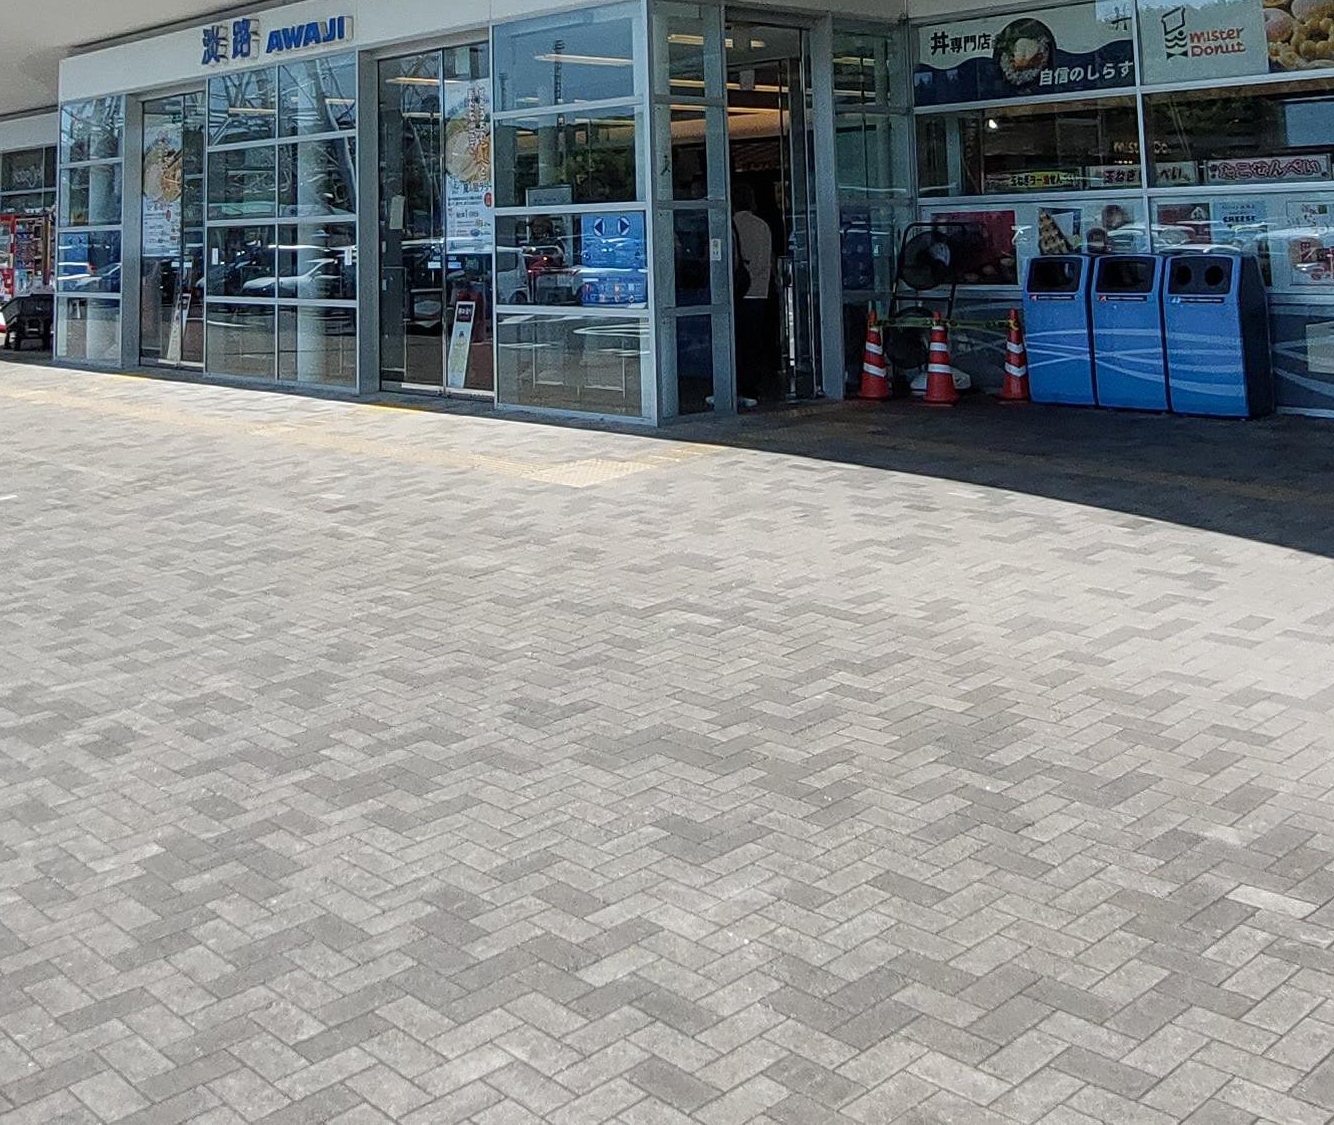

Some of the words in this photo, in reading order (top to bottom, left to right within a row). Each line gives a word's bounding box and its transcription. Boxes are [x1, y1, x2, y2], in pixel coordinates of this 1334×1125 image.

[202, 17, 252, 65] 淡路
[266, 15, 345, 53] AWAJI
[930, 31, 992, 56] 丼専門店
[1191, 41, 1246, 57] Donut
[1038, 60, 1134, 87] 自信のしらす
[1217, 158, 1320, 180] たこせんべい
